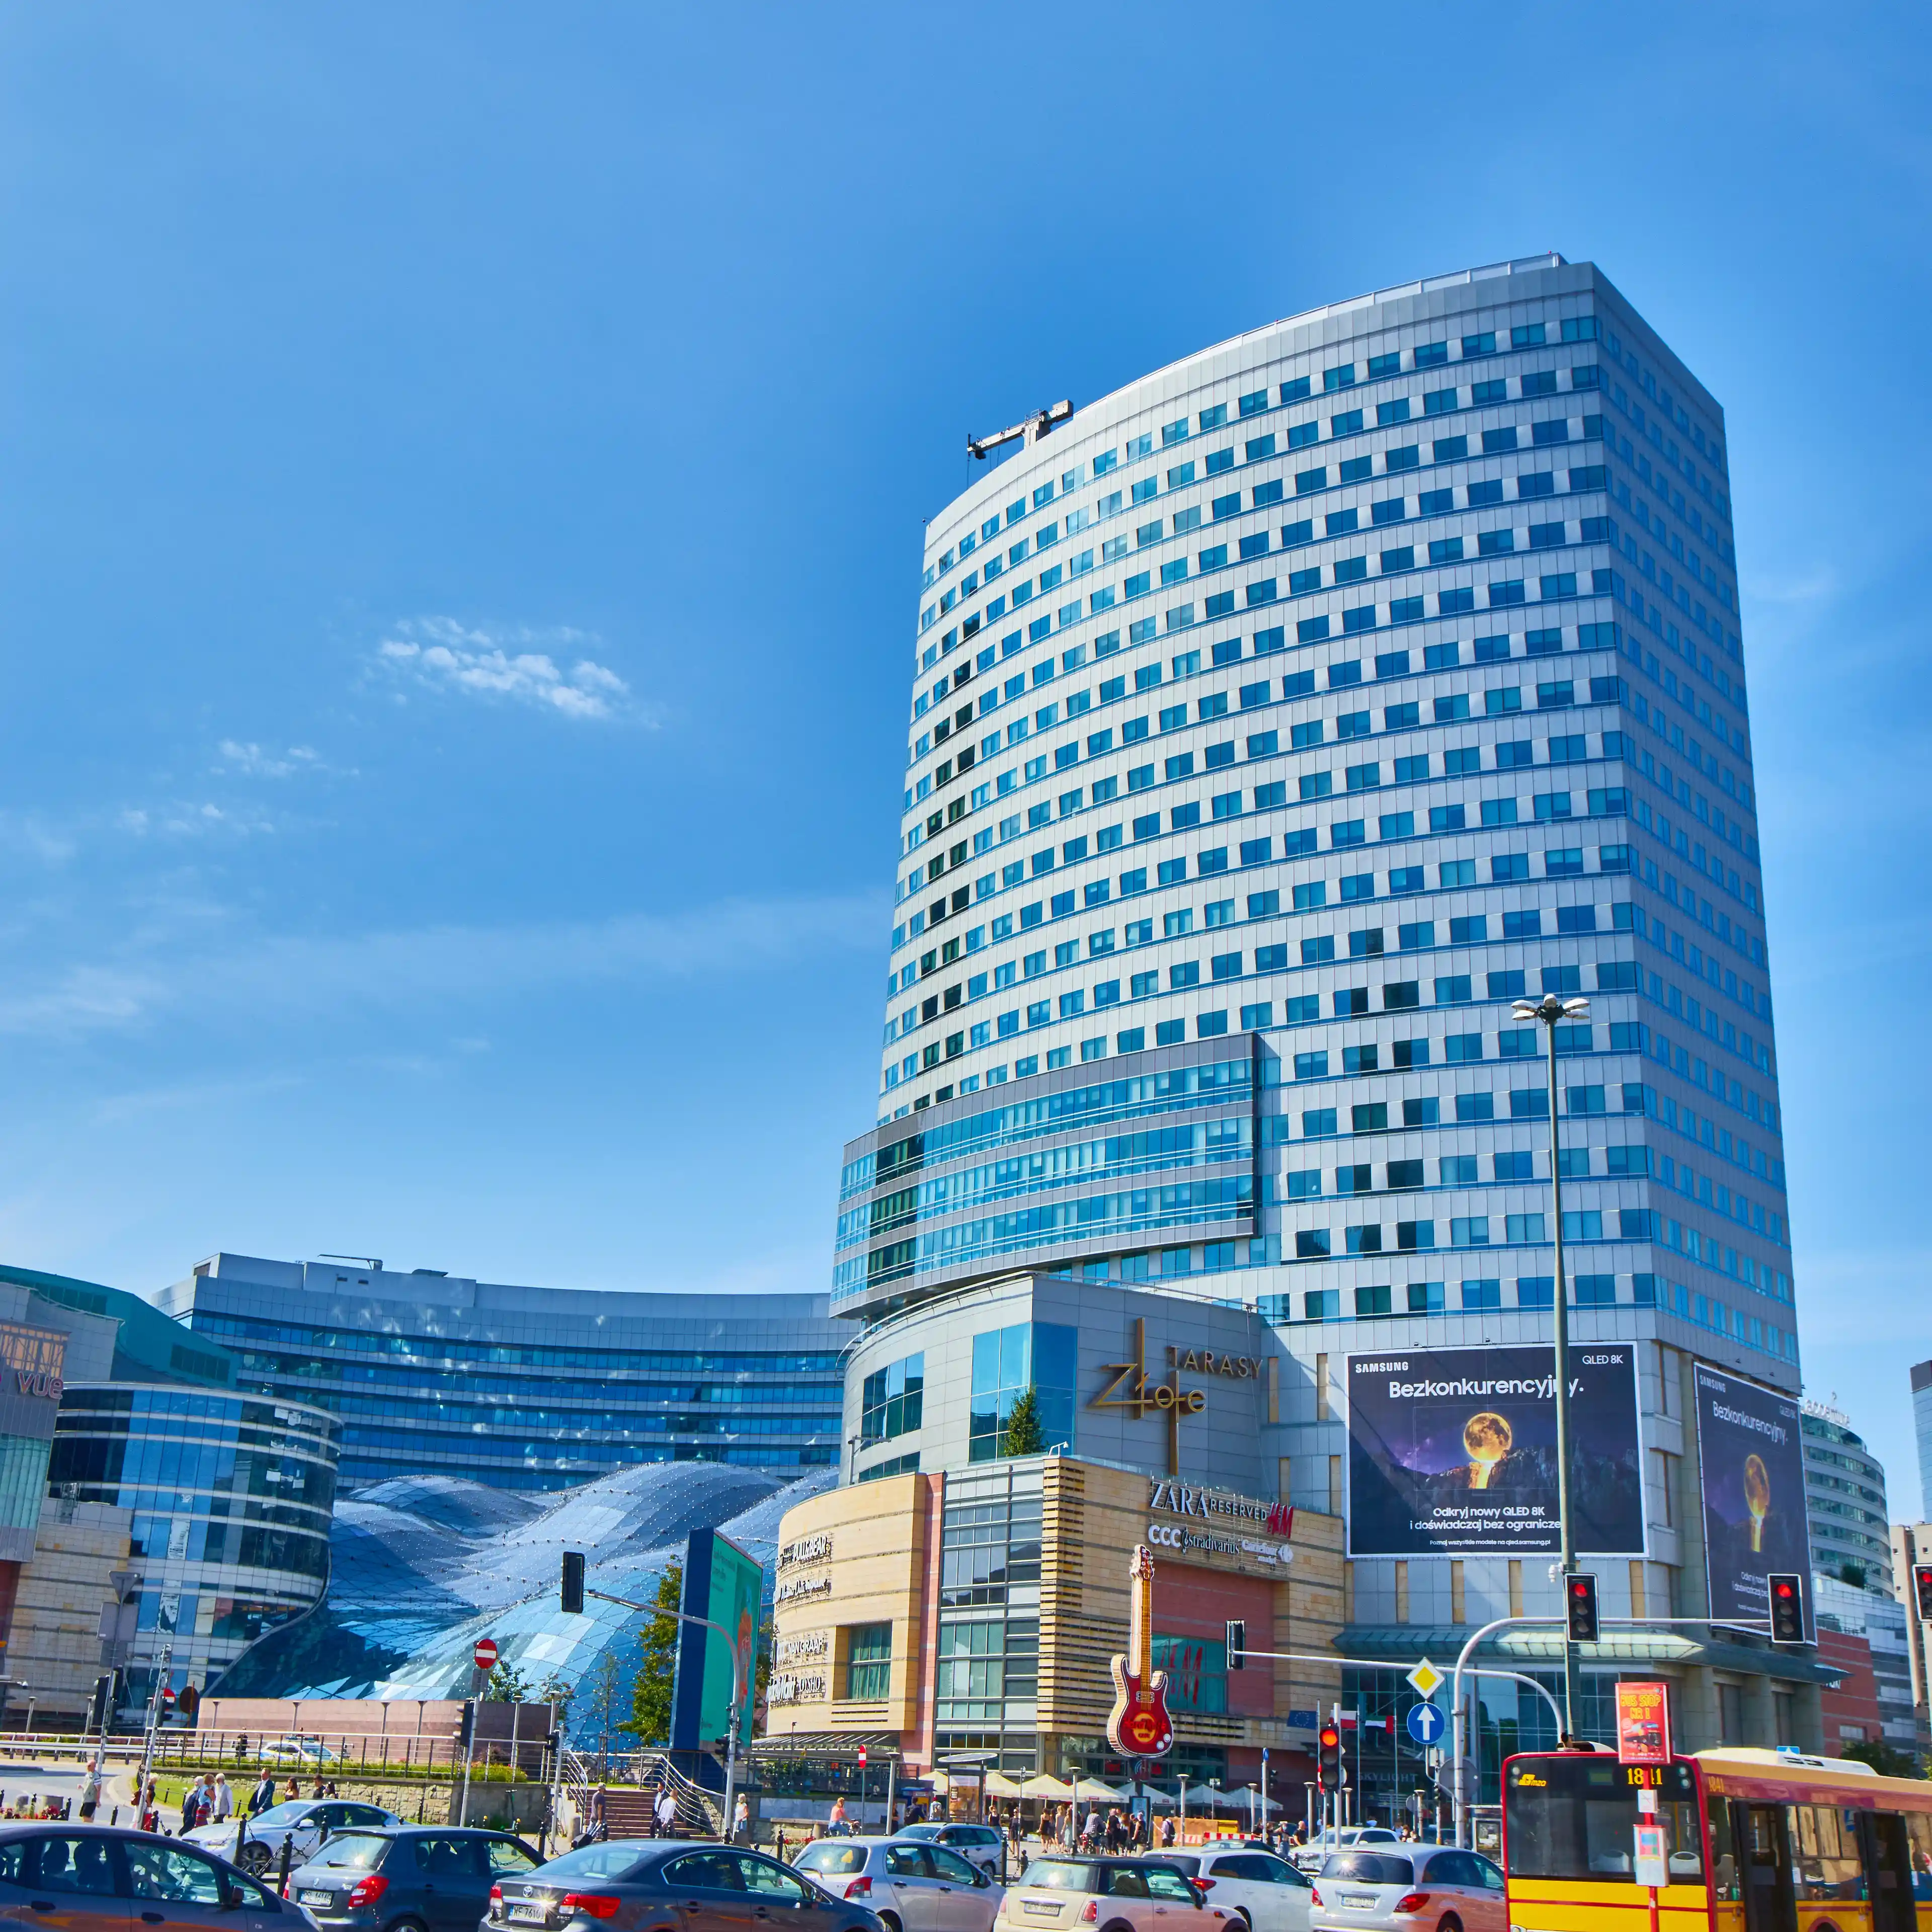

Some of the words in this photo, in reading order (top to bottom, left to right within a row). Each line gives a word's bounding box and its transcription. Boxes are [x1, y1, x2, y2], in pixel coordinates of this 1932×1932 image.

[1168, 1345, 1264, 1379] TARASY
[1582, 1354, 1609, 1364] QLED
[1611, 1354, 1624, 1364] 8K
[1355, 1361, 1409, 1374] SAMSUNG
[1700, 1375, 1726, 1393] SAMSUNG
[1091, 1317, 1206, 1476] Złote
[1713, 1400, 1788, 1445] Bezkonkurencyjny.
[1150, 1481, 1211, 1518] ZARA
[1210, 1498, 1267, 1521] RESERVED
[1266, 1501, 1294, 1539] H&M
[1433, 1506, 1469, 1519] Odkryj
[1470, 1508, 1501, 1519] nowy
[1502, 1506, 1530, 1516] QLED
[1531, 1506, 1546, 1516] 8K
[1409, 1520, 1413, 1530] i
[1414, 1518, 1482, 1532] doświadczaj
[1483, 1519, 1504, 1529] bez
[1148, 1524, 1181, 1548] CCC
[799, 1676, 822, 1692] OYSHO
[1621, 1695, 1638, 1707] BUS
[1639, 1695, 1661, 1707] STOP
[1630, 1707, 1643, 1719] NR
[1645, 1708, 1651, 1720] 1
[1357, 1772, 1419, 1783] SKYLIGHT
[1708, 1776, 1725, 1793] 1841
